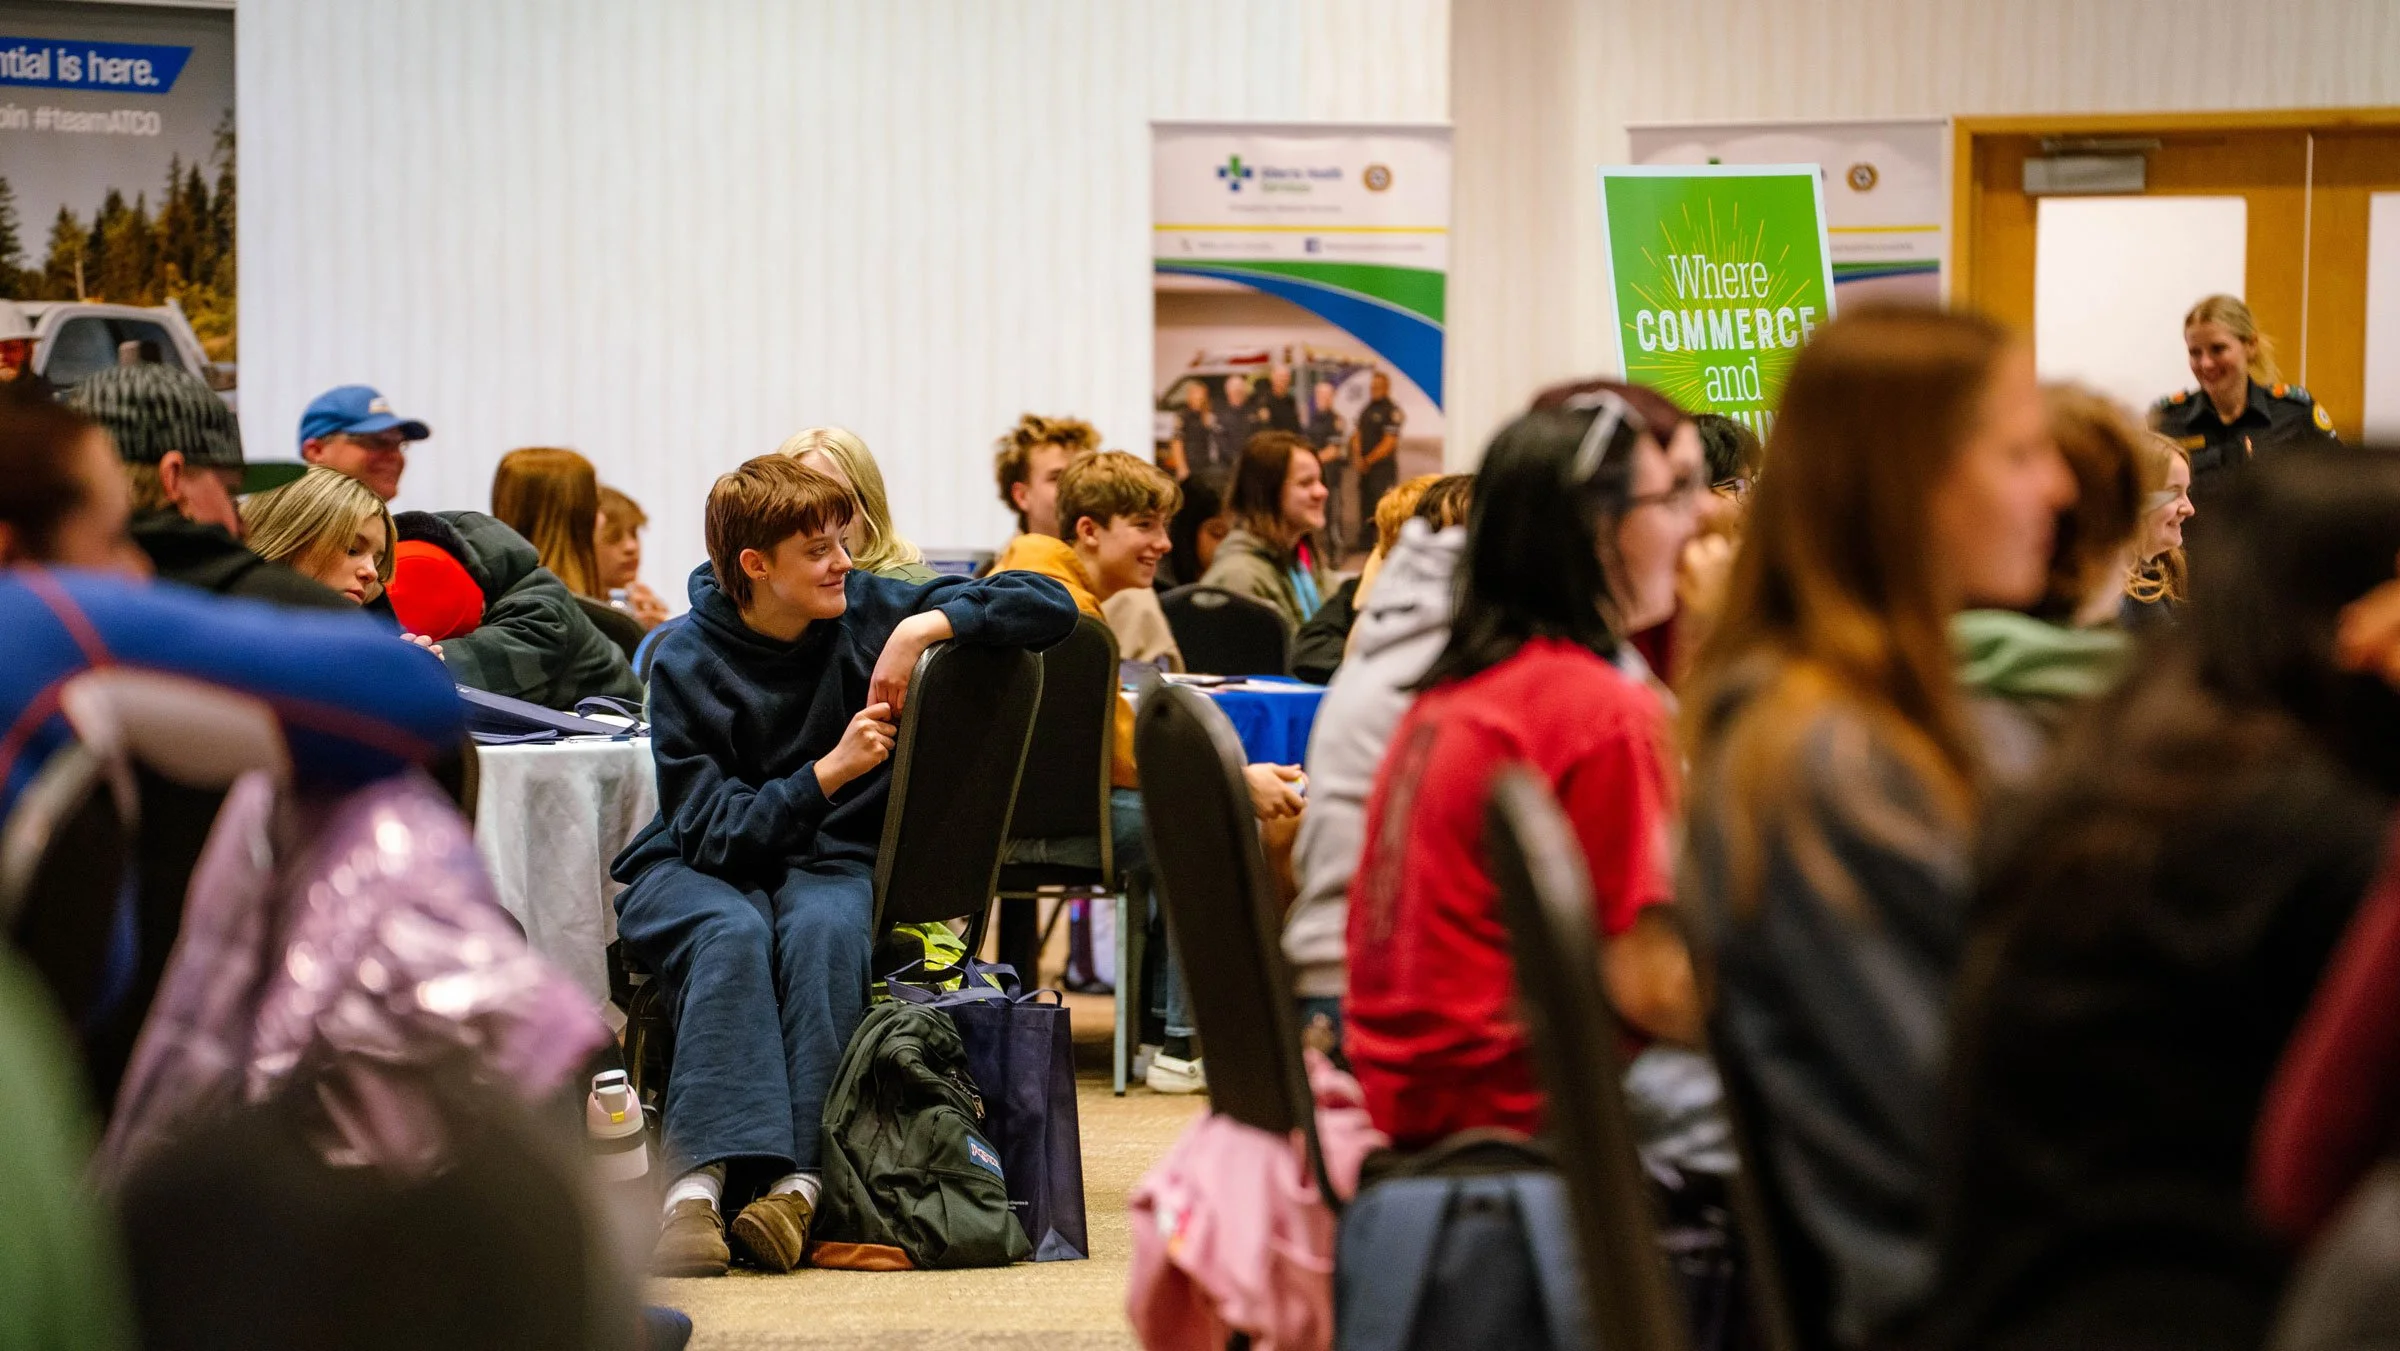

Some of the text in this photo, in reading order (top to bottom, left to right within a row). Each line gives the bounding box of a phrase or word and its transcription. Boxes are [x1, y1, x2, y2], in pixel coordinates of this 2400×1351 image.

[57, 48, 82, 82] is
[88, 50, 160, 86] here.
[35, 106, 161, 136] #teamATCO
[1668, 254, 1769, 300] Where
[1637, 307, 1815, 352] COMMERCE
[1704, 356, 1764, 402] and
